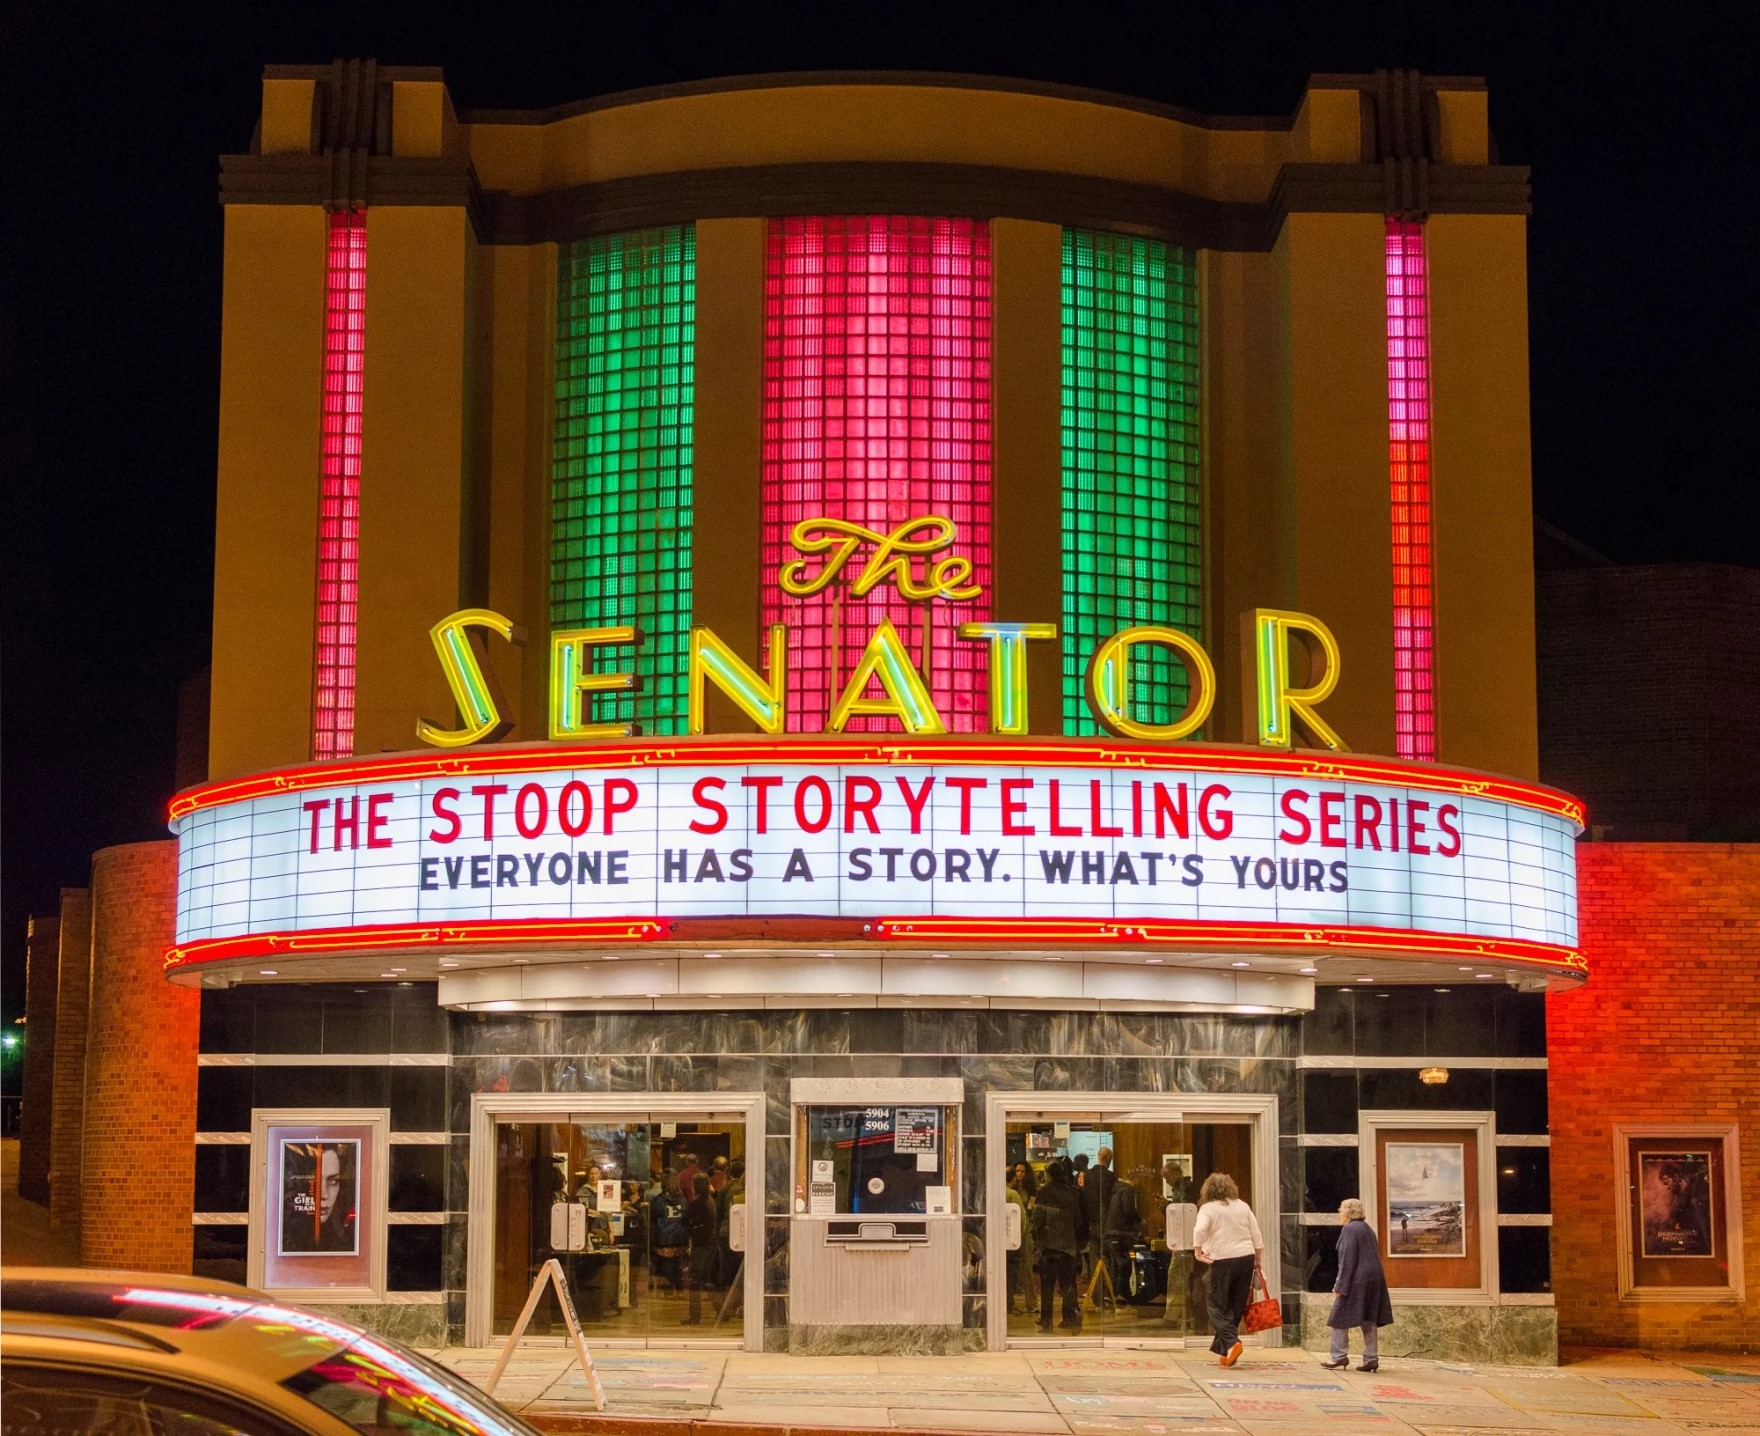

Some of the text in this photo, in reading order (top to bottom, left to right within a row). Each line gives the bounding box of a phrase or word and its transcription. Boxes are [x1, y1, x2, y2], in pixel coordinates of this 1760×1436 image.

[779, 516, 983, 601] The
[416, 608, 1348, 751] SENATOR
[301, 775, 1463, 858] THE STOOP STORYTELLING SERIES
[420, 847, 1349, 893] EVERYONE HAS A STORY. WHAT'S YOURS
[865, 1108, 890, 1119] 5904
[865, 1120, 890, 1131] 5906
[294, 1196, 316, 1204] GIRL
[666, 1204, 682, 1218] E
